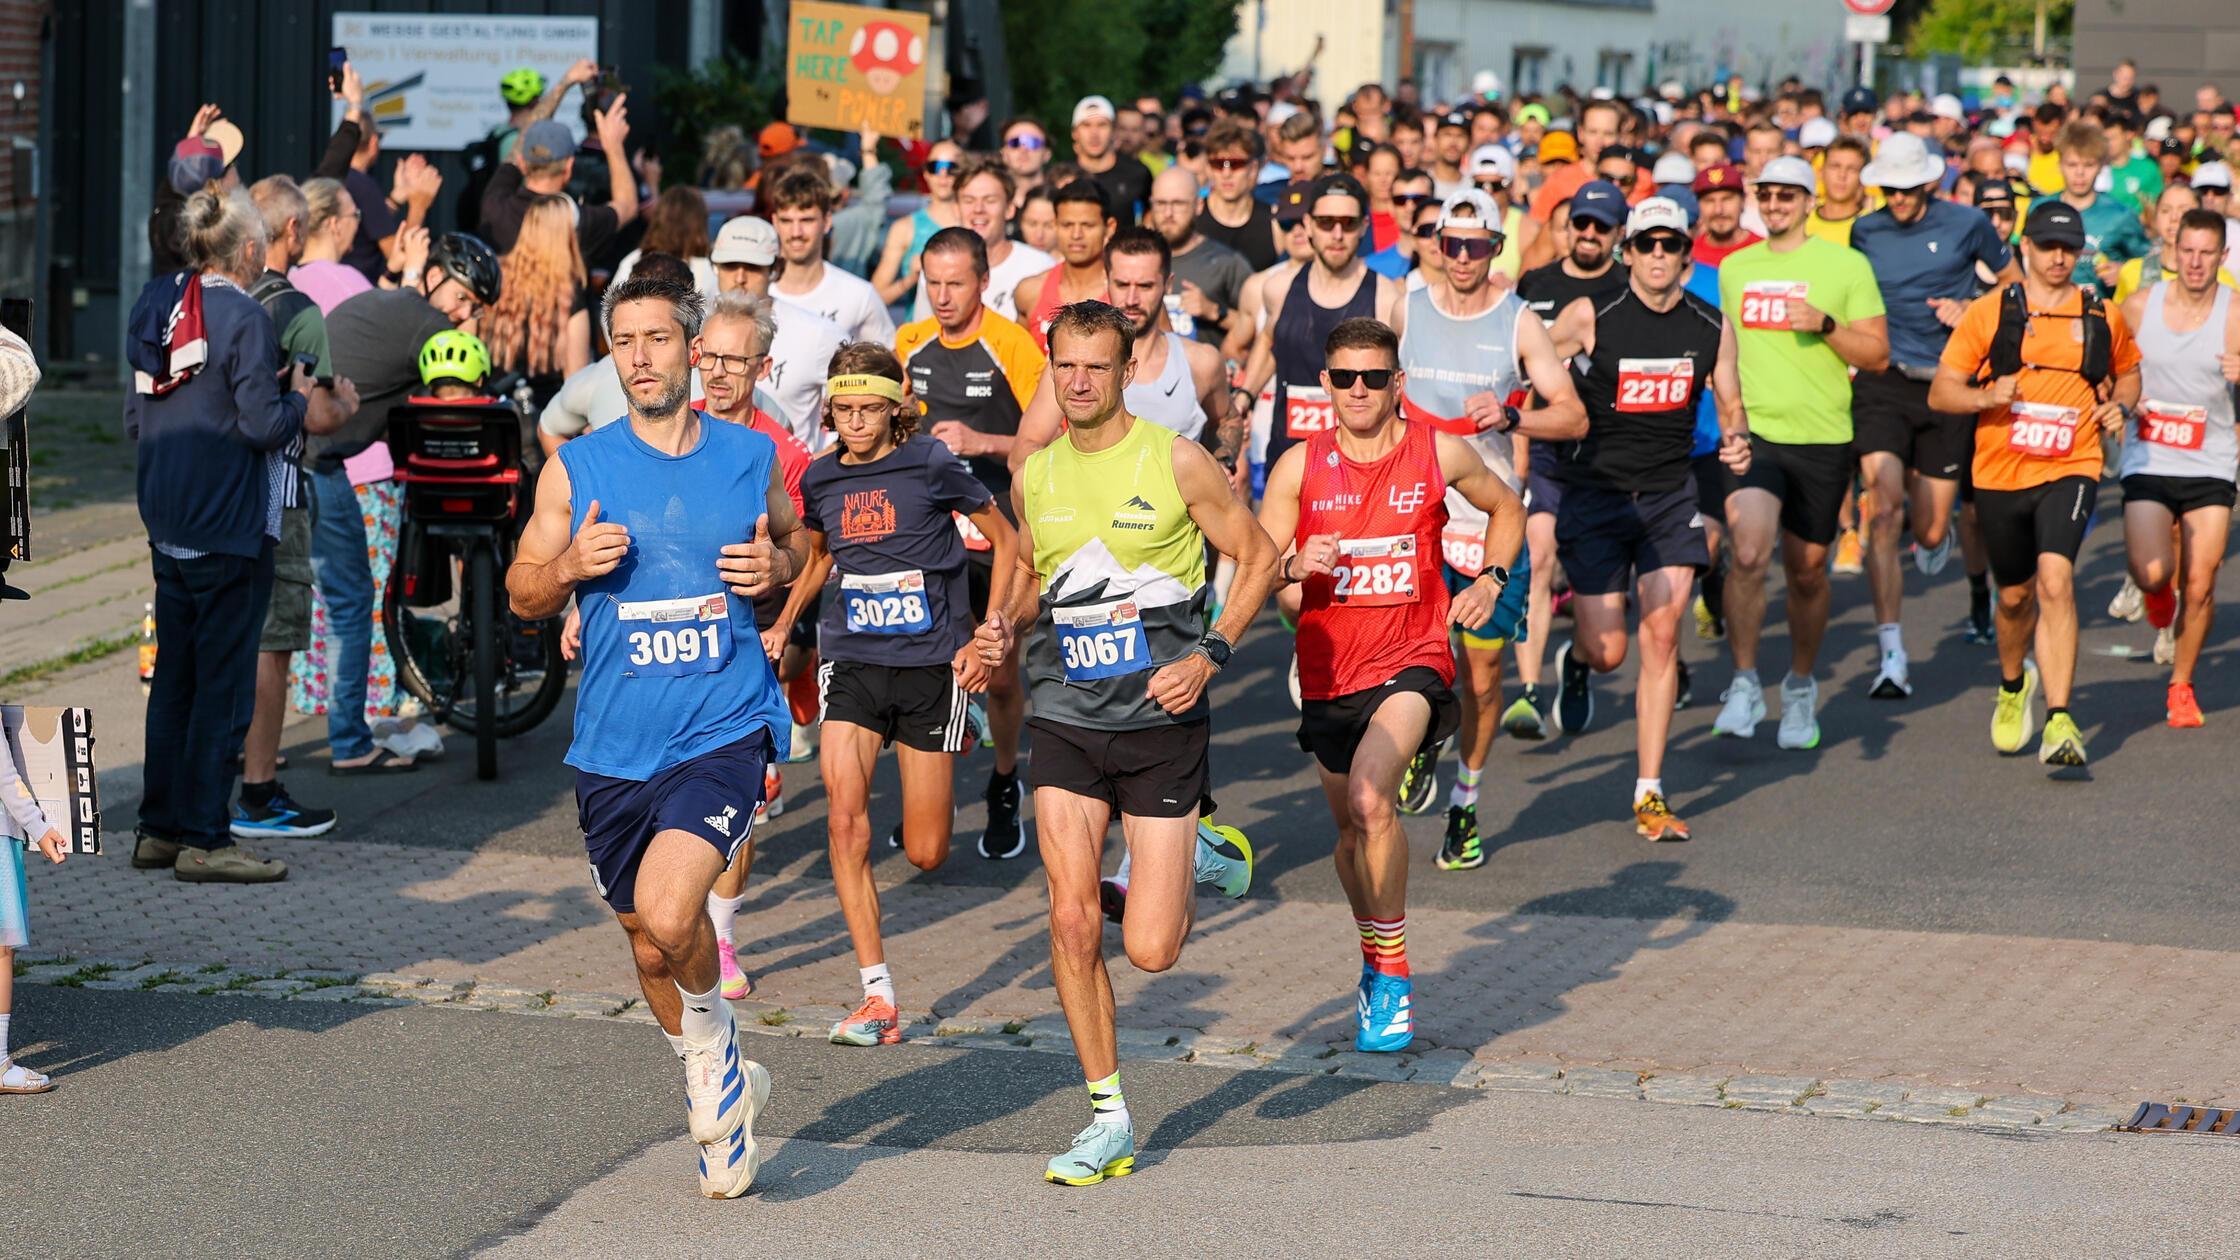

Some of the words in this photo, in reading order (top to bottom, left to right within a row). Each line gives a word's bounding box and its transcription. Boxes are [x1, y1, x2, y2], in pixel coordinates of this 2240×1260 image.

[798, 17, 845, 46] TAP
[796, 54, 849, 85] HERE
[838, 88, 906, 132] POWER
[1621, 378, 1688, 405] 2218
[2011, 420, 2073, 452] 2079
[2148, 418, 2194, 446] 798
[844, 489, 887, 510] NATURE
[1312, 500, 1333, 512] RUN
[1335, 494, 1362, 505] HIKE
[1111, 519, 1155, 531] Runners
[1332, 561, 1414, 596] 2282
[850, 595, 925, 628] 3028
[628, 623, 720, 666] 3091
[1062, 627, 1137, 669] 3067
[722, 804, 738, 819] PW
[703, 816, 731, 838] adidas
